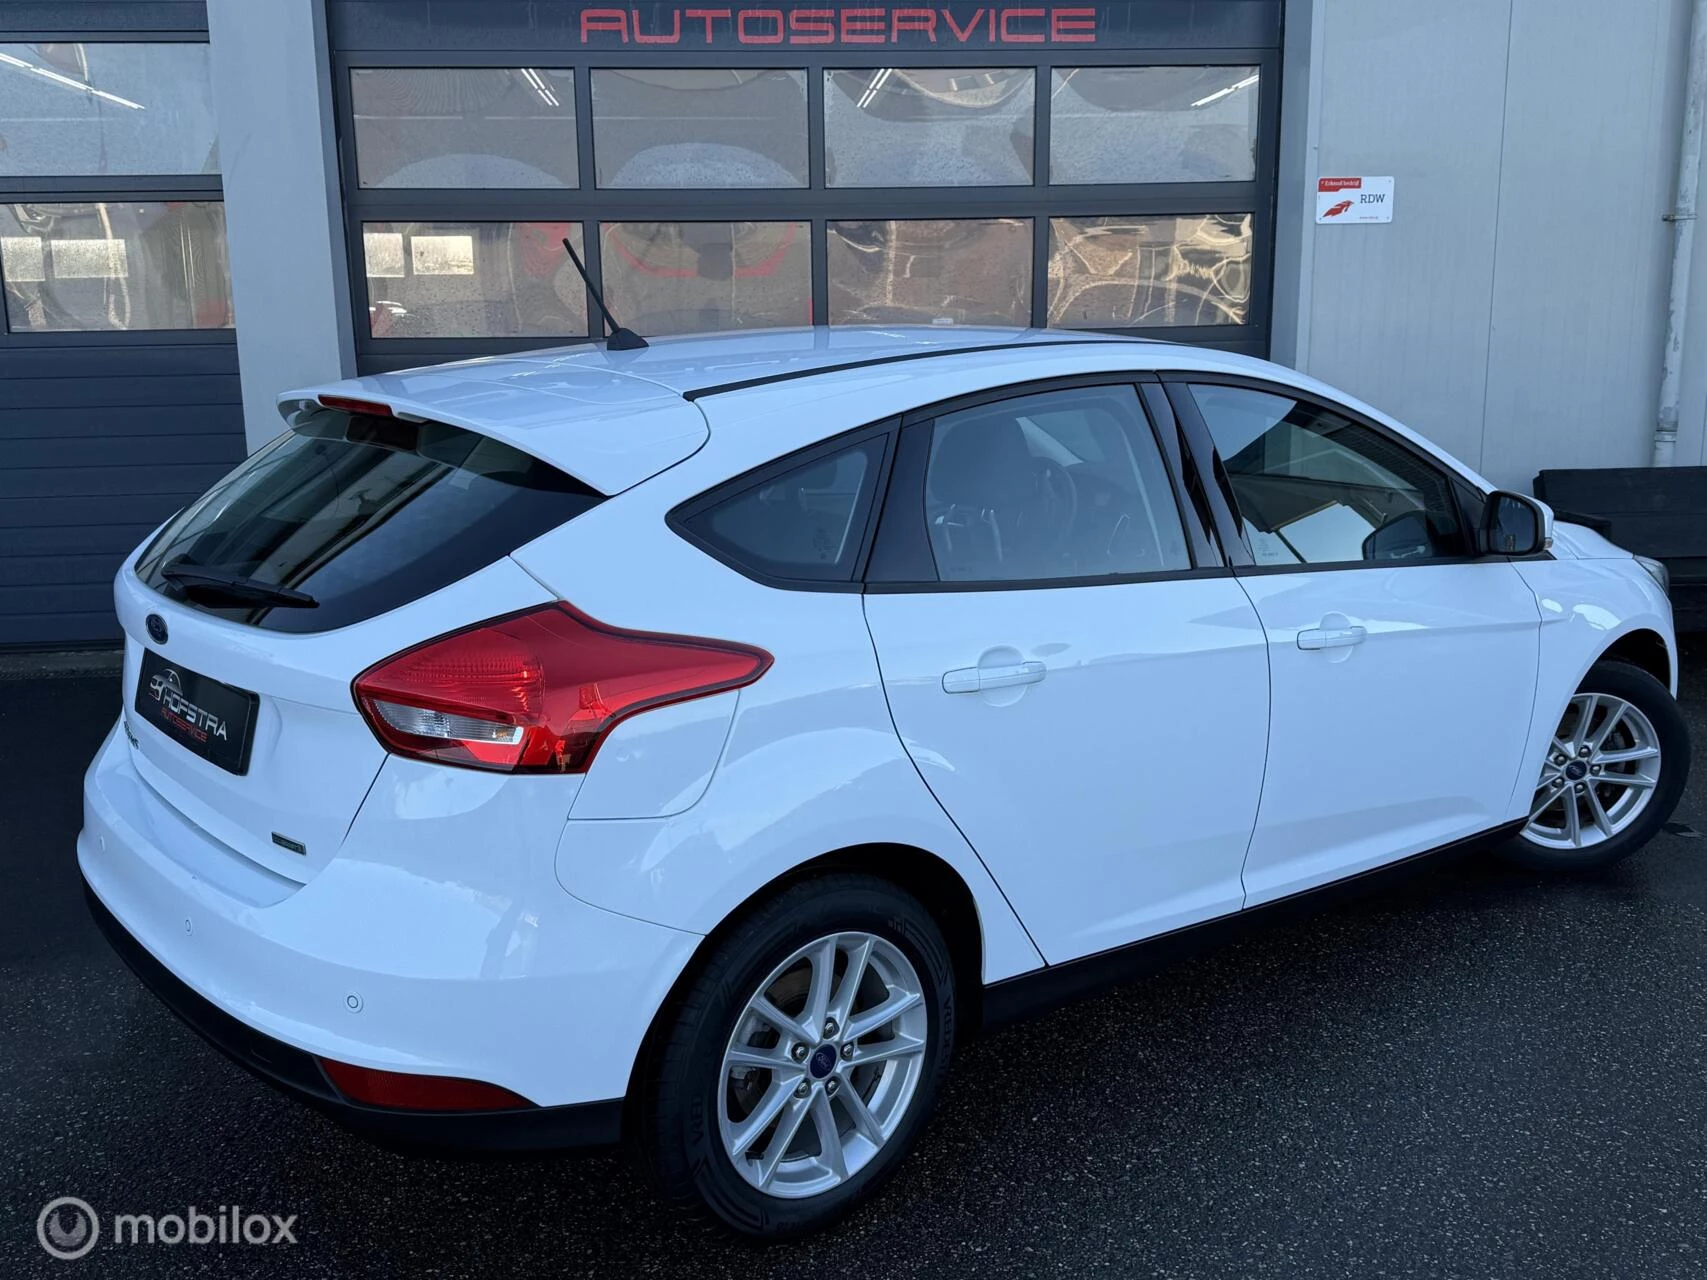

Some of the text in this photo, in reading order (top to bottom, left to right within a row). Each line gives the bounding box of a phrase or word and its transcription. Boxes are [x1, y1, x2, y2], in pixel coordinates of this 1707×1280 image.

[580, 8, 1096, 44] AUTOSERVICE
[1360, 194, 1385, 204] RDW
[163, 688, 228, 741] HOFSTRA
